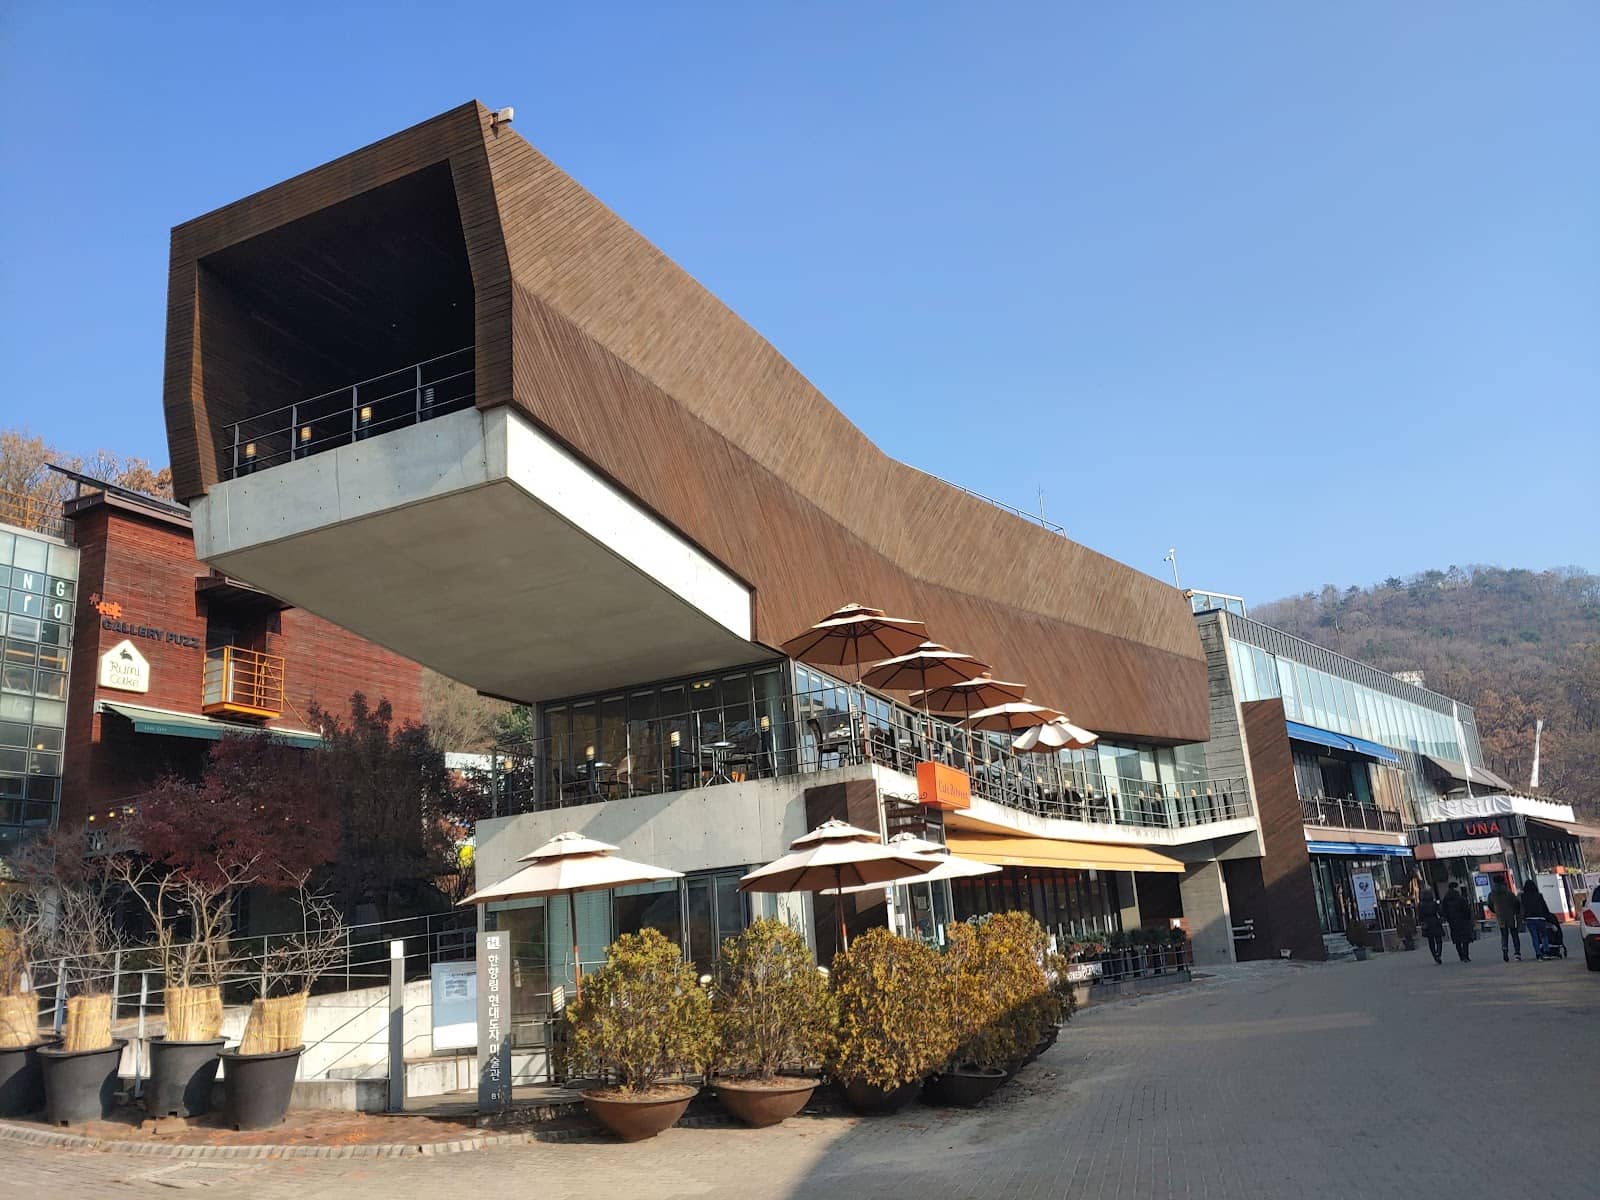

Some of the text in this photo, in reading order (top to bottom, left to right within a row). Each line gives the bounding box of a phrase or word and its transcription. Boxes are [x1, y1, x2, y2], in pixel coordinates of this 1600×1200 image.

[102, 618, 200, 649] GALLERY PUZZ
[1466, 822, 1500, 836] UNA
[488, 954, 500, 992] 한향림
